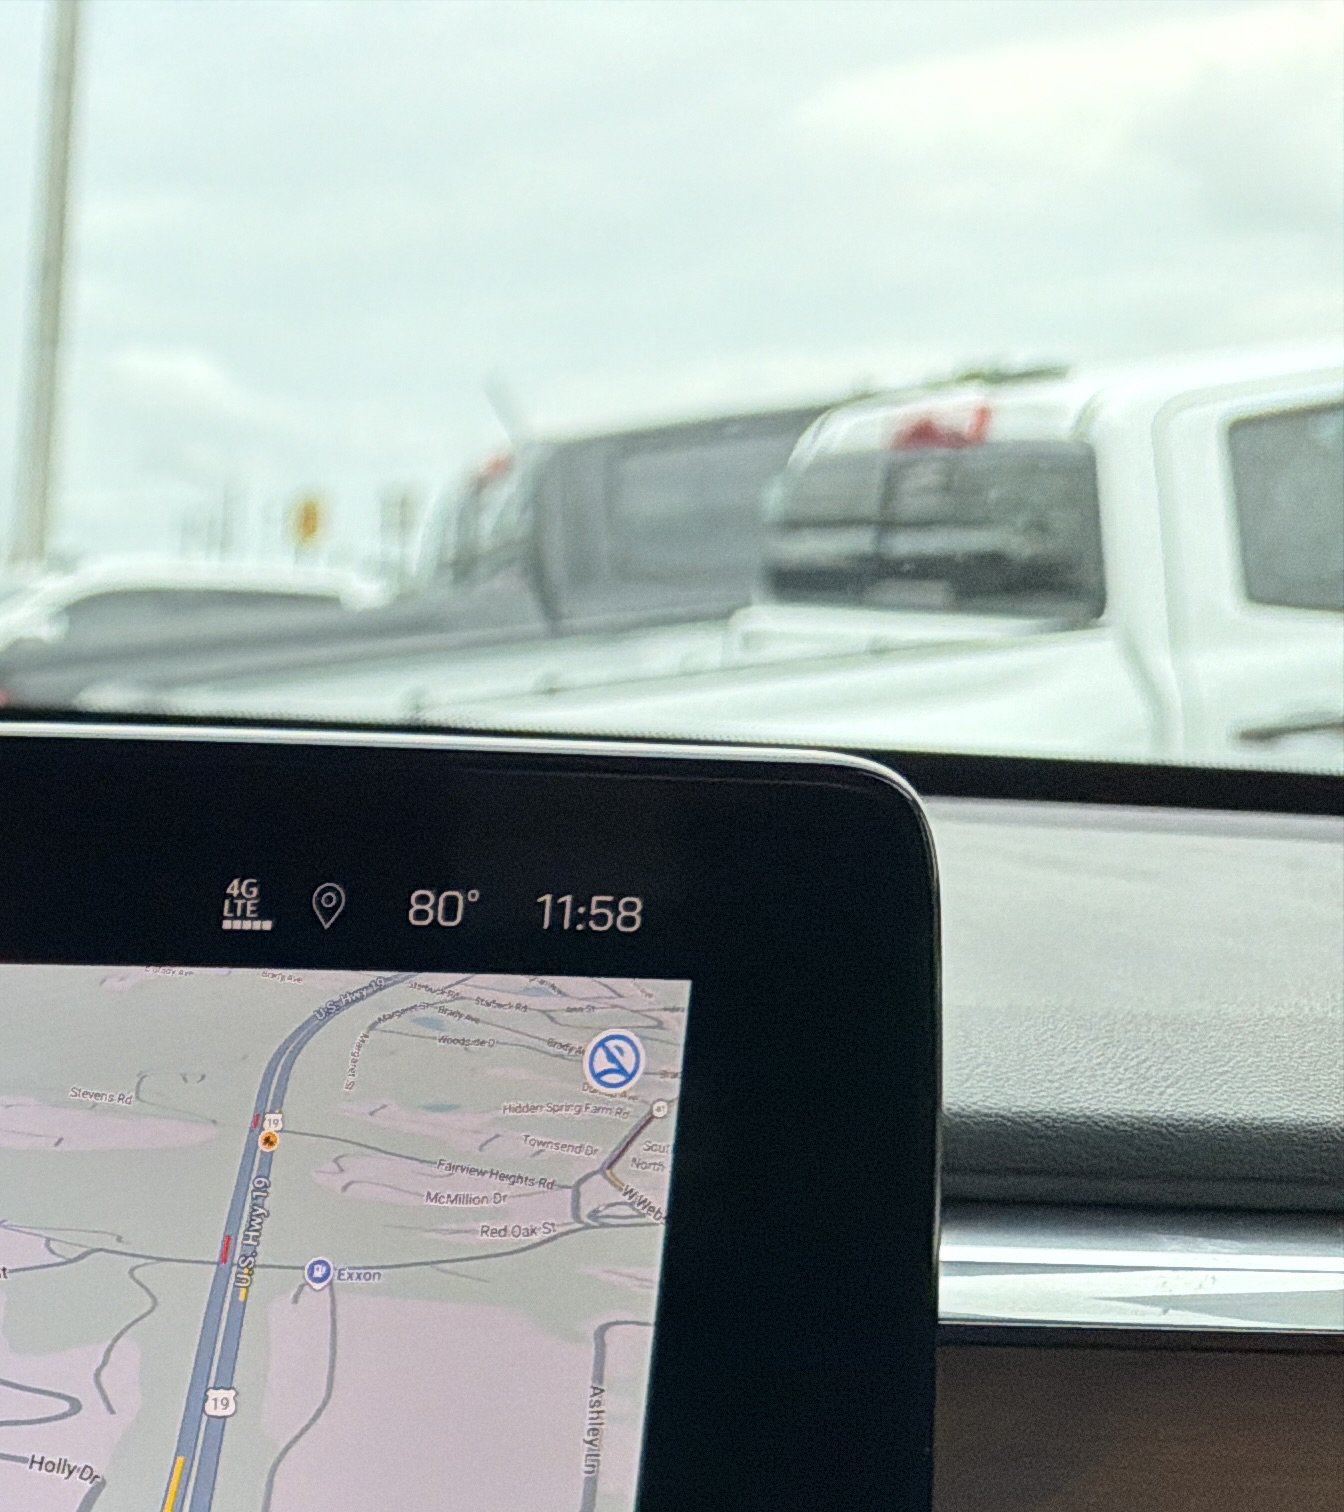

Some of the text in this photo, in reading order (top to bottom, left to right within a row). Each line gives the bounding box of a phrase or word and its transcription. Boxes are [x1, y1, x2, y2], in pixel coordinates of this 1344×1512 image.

[226, 878, 258, 898] 4G
[223, 899, 259, 918] LTE
[408, 889, 480, 928] 80°
[536, 892, 644, 933] 11:58
[372, 975, 386, 990] 19
[70, 1086, 133, 1105] Stevens Rd
[502, 1103, 544, 1114] Hidden
[547, 1102, 582, 1115] Spring
[584, 1104, 612, 1115] Farm
[523, 1134, 599, 1156] Townsend Dr
[437, 1159, 557, 1190] Fairview Heights Rd
[425, 1191, 509, 1205] McMillion Dr
[234, 1177, 271, 1288] U.S. Hwy 19
[480, 1220, 558, 1238] Red Oak St
[336, 1268, 382, 1281] Exxon
[212, 1396, 230, 1411] 19
[583, 1384, 606, 1476] Ashley Ln
[28, 1454, 101, 1484] Holly Dr
